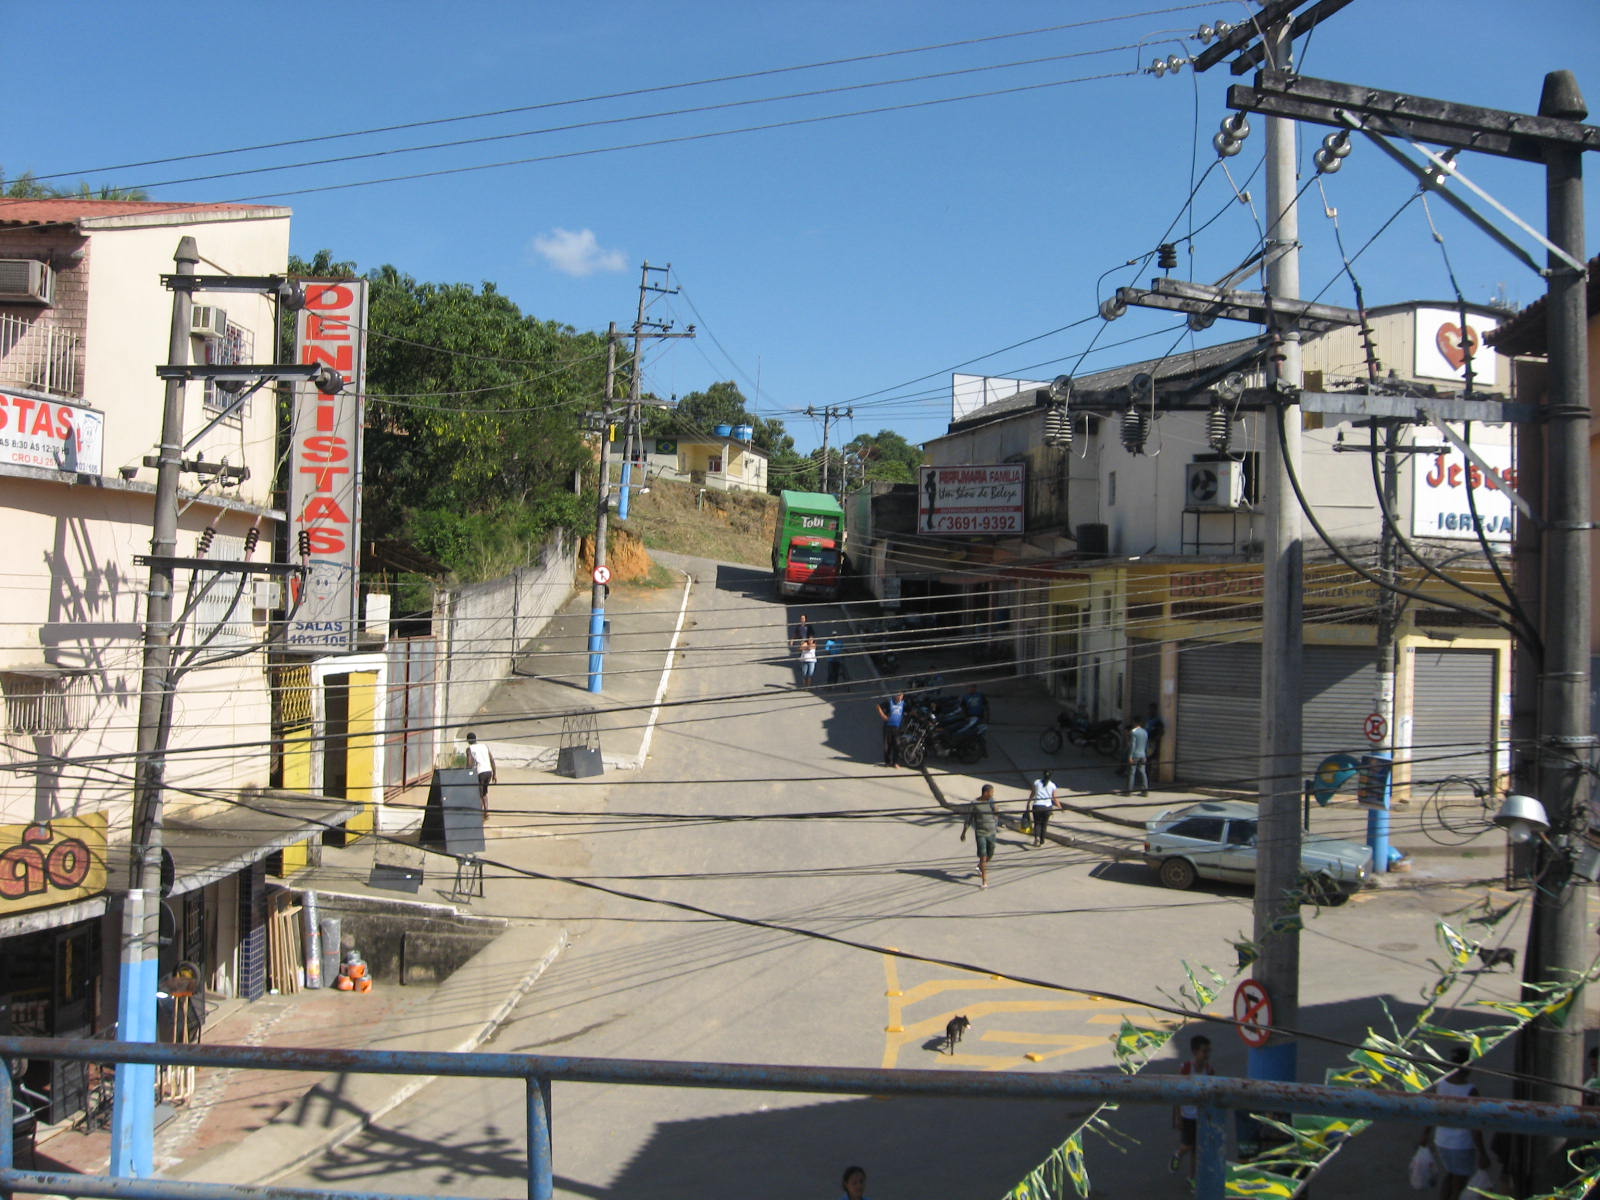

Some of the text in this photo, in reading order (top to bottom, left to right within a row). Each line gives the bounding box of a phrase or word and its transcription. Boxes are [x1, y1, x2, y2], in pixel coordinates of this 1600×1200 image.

[801, 516, 825, 528] Tobi
[946, 515, 1016, 531] 3691-9392
[295, 621, 343, 632] SALAS
